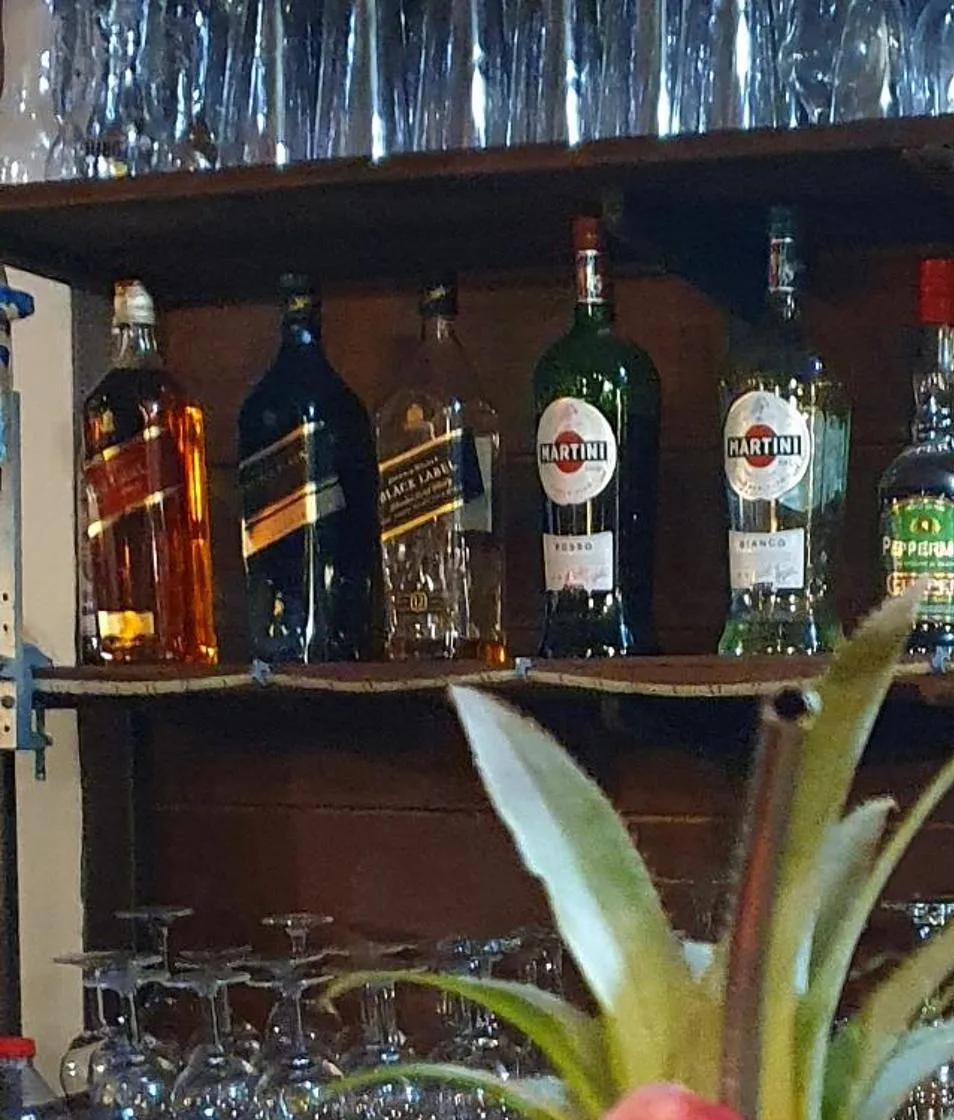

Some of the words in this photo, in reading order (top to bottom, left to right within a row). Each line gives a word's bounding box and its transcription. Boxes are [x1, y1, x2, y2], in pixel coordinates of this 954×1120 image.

[541, 441, 606, 461] MARTINI
[729, 436, 799, 457] MARTINI
[380, 478, 417, 504] BLACK
[417, 459, 457, 485] LABEL
[739, 537, 787, 549] BIANCO
